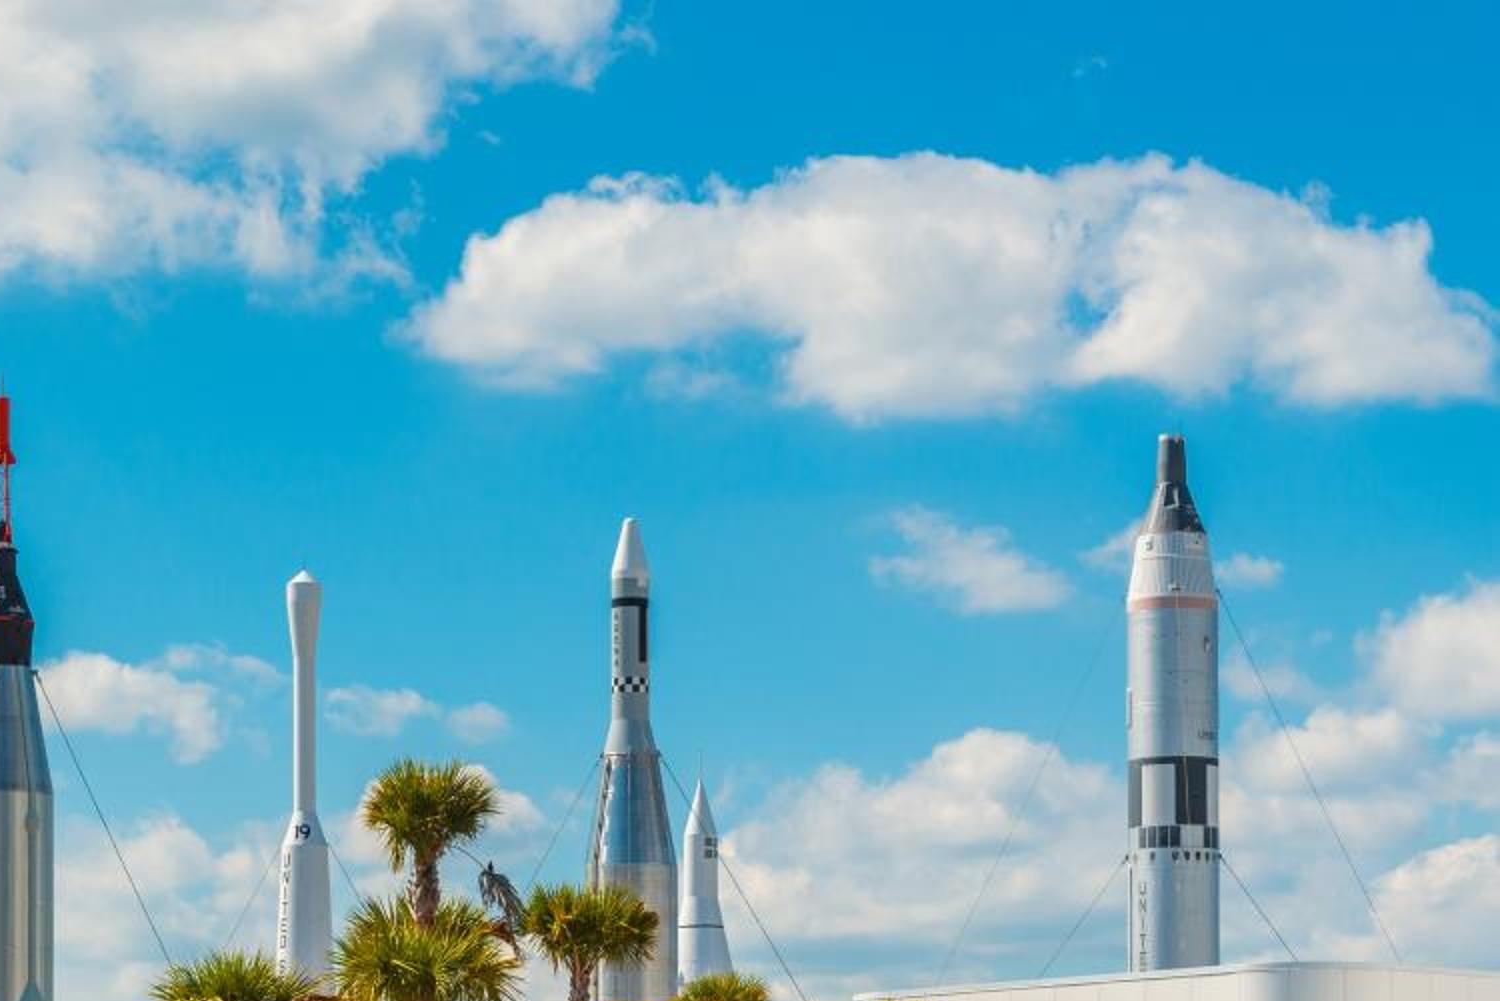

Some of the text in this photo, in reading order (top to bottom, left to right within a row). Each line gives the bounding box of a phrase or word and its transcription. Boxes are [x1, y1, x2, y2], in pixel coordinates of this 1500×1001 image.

[294, 823, 311, 840] 19
[279, 852, 291, 949] UNITED
[1139, 881, 1147, 972] UNITE
